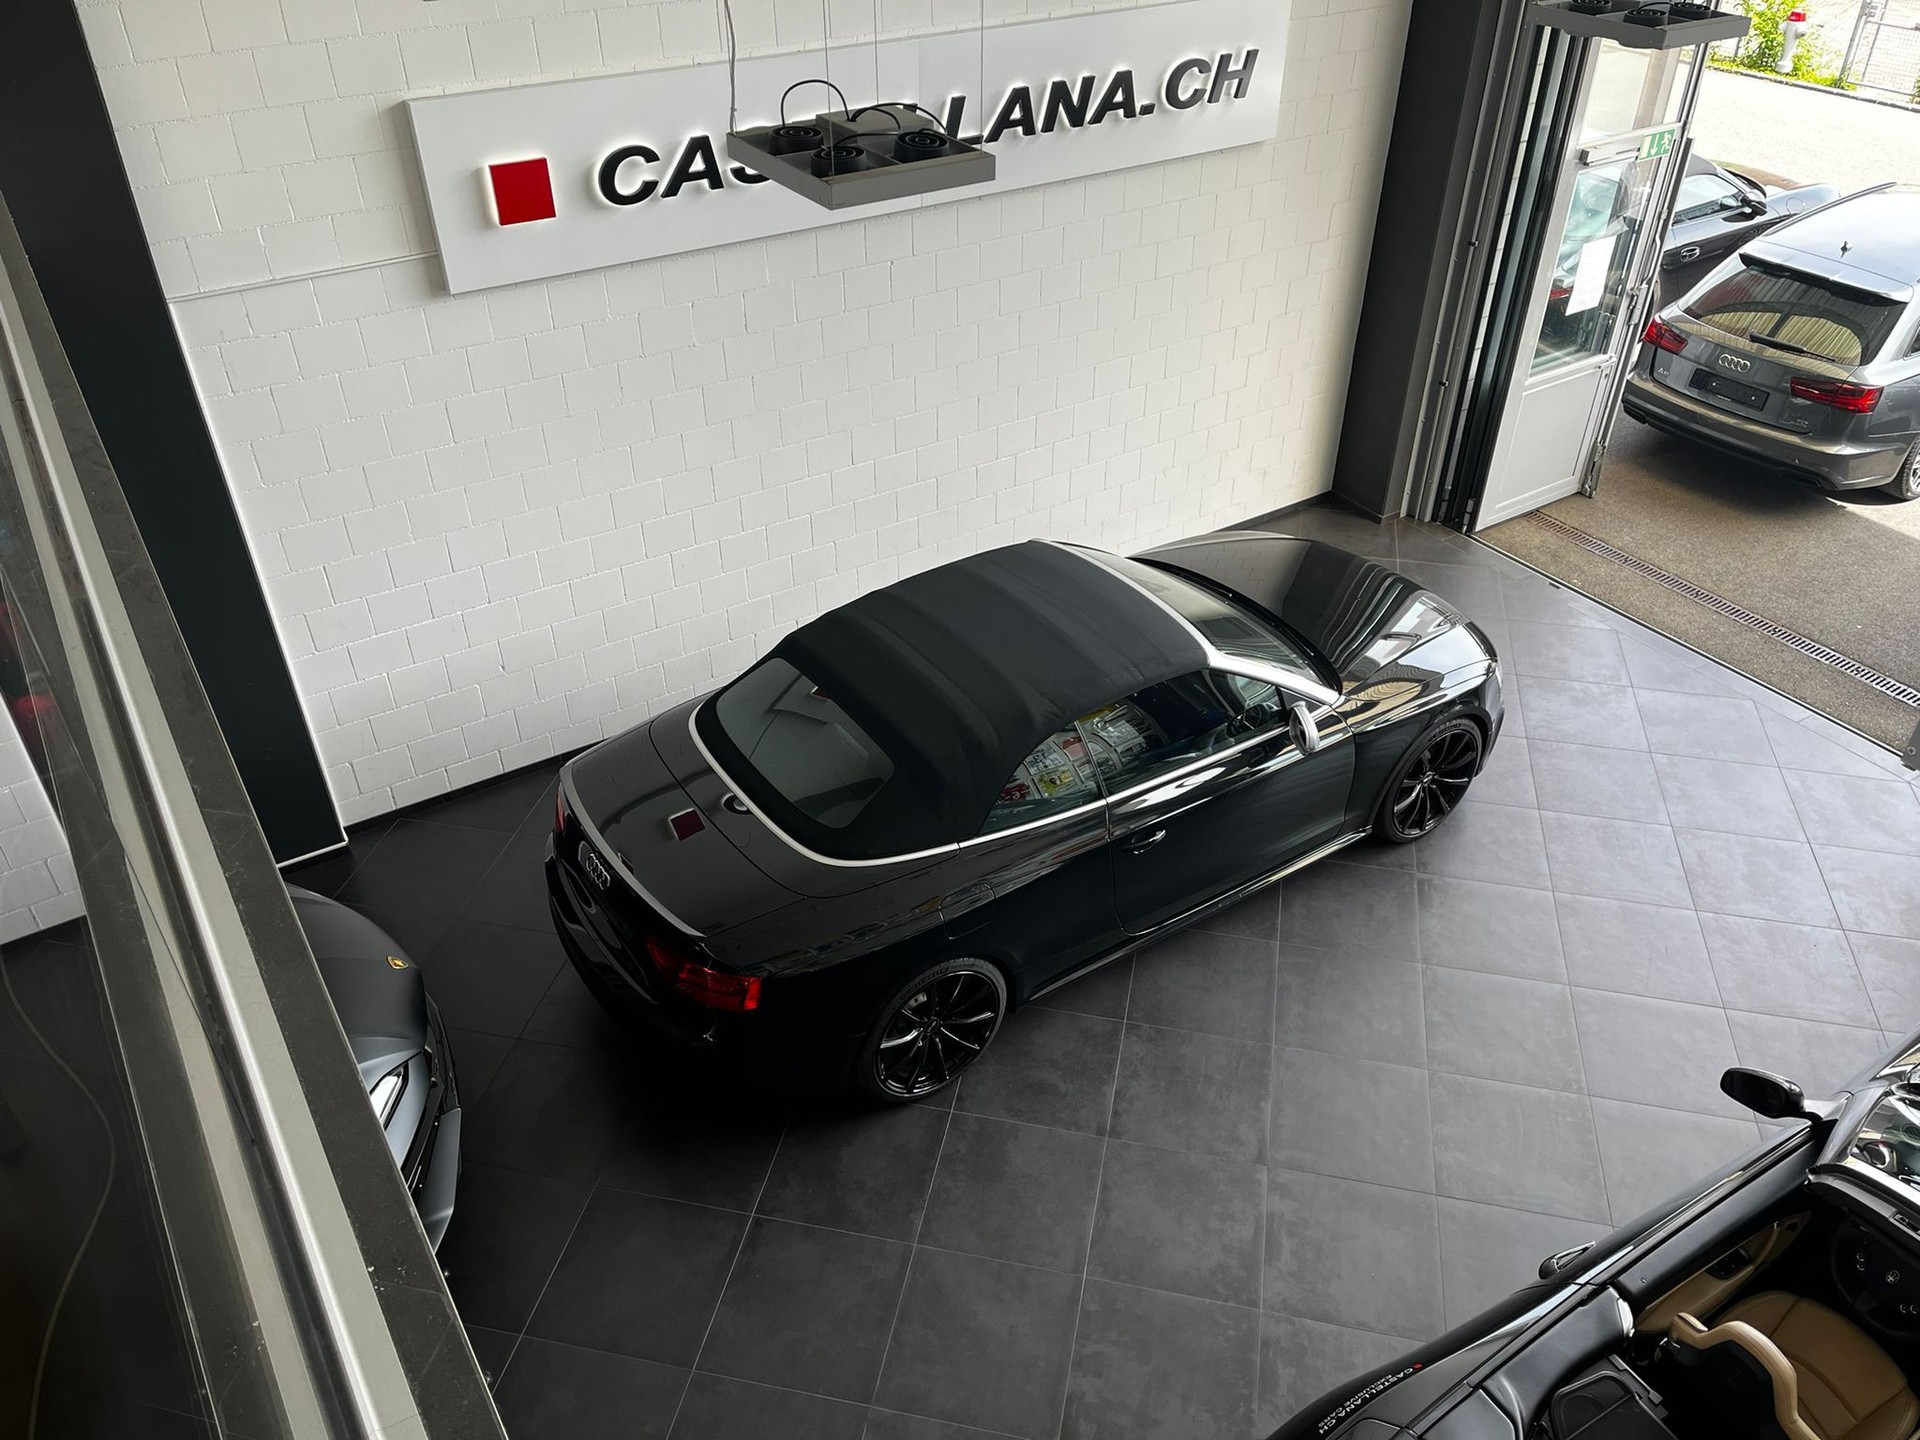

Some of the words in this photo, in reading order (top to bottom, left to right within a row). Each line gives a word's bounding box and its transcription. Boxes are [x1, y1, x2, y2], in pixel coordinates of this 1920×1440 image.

[598, 48, 1260, 206] CALANA.CH
[1319, 1368, 1413, 1434] CASTELLANA.CH
[1343, 1374, 1393, 1407] EXCLUSIVE
[1318, 1407, 1343, 1428] CARS
